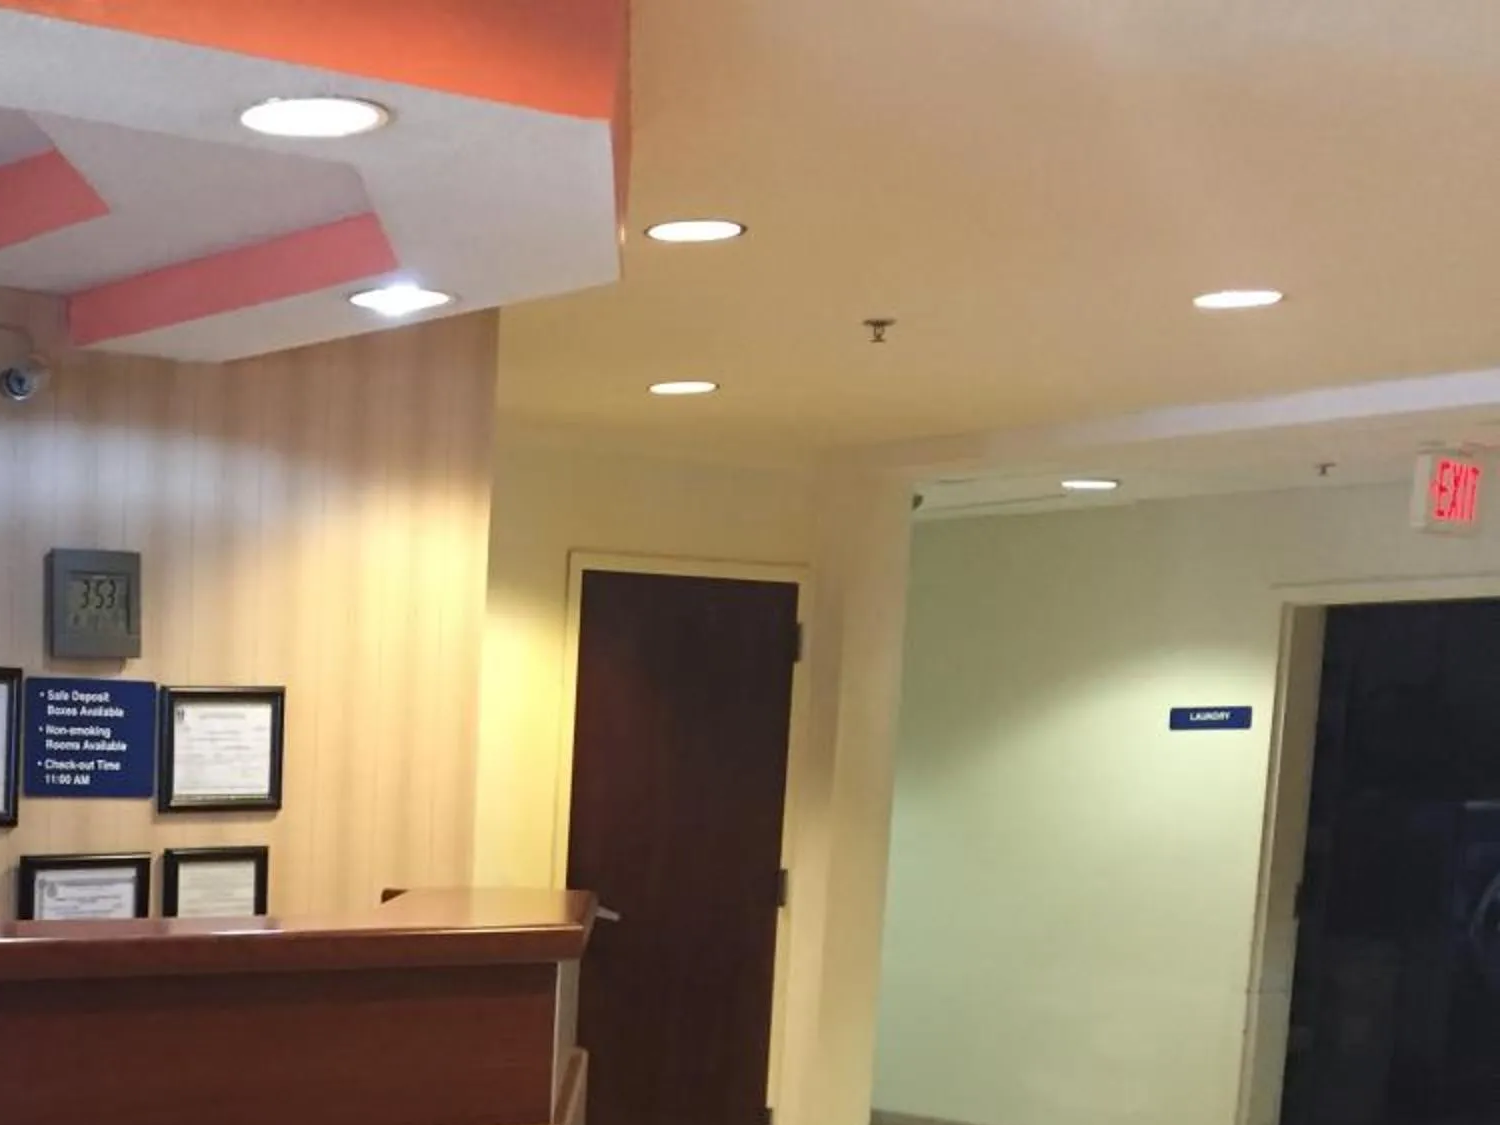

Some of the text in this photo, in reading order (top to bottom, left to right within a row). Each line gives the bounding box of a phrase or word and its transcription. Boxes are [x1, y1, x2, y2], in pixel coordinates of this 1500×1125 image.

[1432, 460, 1481, 523] EXIT
[47, 689, 110, 704] Safe Deposit
[47, 704, 125, 717] Boxes Available
[1189, 711, 1231, 721] LAUNDRY
[45, 724, 112, 739] Non-smoking
[45, 739, 127, 751] Rooms Available
[44, 758, 121, 771] Check-out Time
[45, 773, 91, 785] 11:00 AM
